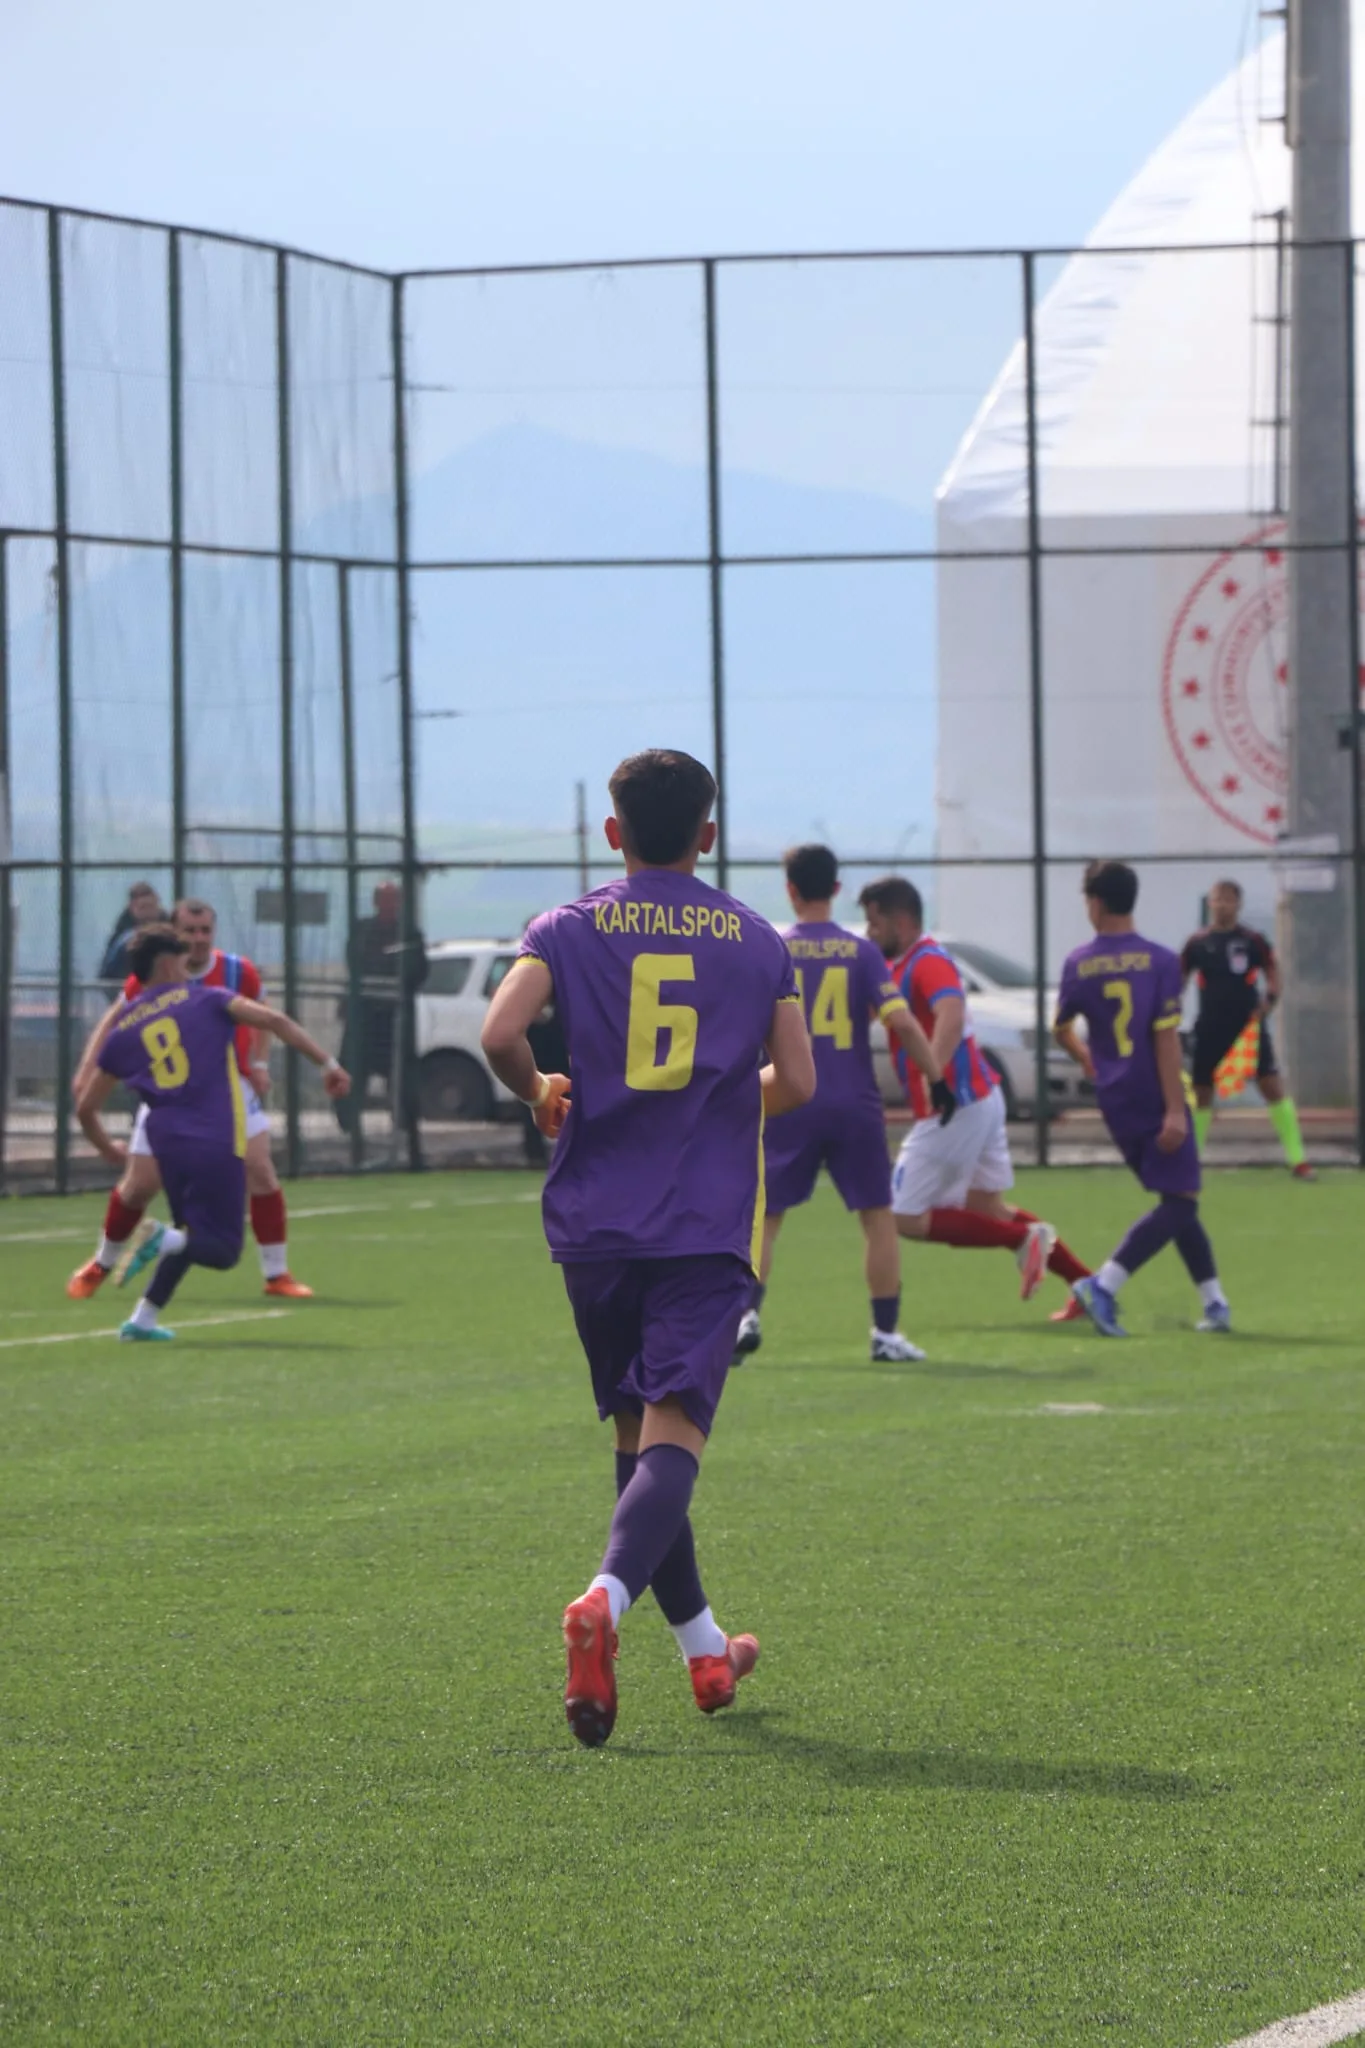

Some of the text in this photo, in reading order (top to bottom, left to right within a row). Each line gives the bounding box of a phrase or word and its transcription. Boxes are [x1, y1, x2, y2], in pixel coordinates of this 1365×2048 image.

[594, 902, 742, 942] KARTALSPOR
[140, 1016, 190, 1090] 8
[625, 952, 699, 1092] 6
[1103, 979, 1134, 1058] 7
